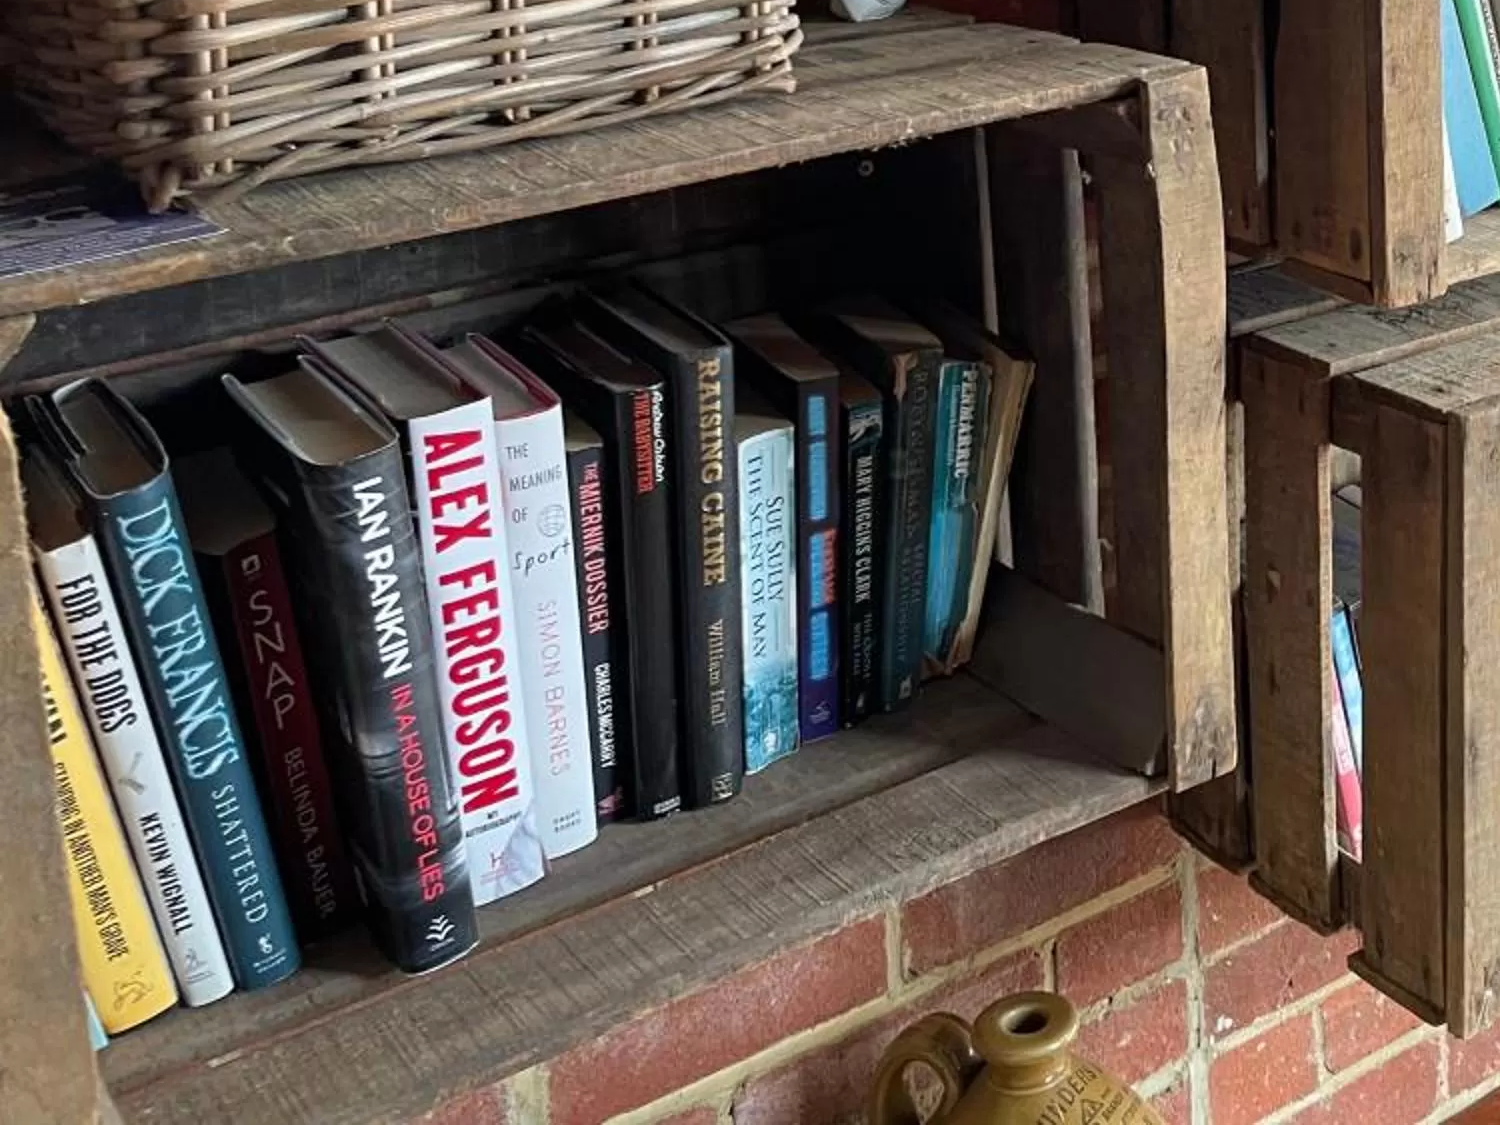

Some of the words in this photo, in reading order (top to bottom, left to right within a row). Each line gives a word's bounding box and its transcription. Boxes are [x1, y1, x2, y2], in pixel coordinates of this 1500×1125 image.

[697, 356, 725, 485] RAISING
[953, 369, 979, 480] PENMARRIC
[504, 443, 529, 462] THE
[508, 465, 564, 492] MEANING
[583, 460, 599, 484] THE
[747, 454, 764, 501] THE
[855, 455, 873, 495] MARY
[351, 475, 390, 543] IAN
[422, 429, 493, 555] ALEX
[511, 506, 530, 525] OF
[578, 481, 606, 559] MIERNIK
[765, 495, 784, 540] SUE
[116, 496, 193, 616] DICK
[701, 491, 727, 587] CAINE
[749, 503, 768, 574] SCENT
[855, 495, 873, 557] HIGGINS
[512, 539, 572, 578] Sport
[766, 543, 787, 603] SULLY
[854, 556, 872, 604] CLARK
[55, 573, 104, 624] FOR
[363, 544, 414, 680] RANKIN
[583, 557, 610, 636] DOSSIER
[752, 575, 768, 609] OF
[71, 620, 119, 671] THE
[249, 589, 296, 730] SNAP
[537, 600, 561, 679] SIMON
[708, 618, 726, 688] William
[752, 611, 769, 660] MAY
[85, 667, 139, 735] DOGS
[147, 604, 240, 779] FRANCIS
[390, 682, 414, 711] IN
[438, 559, 520, 814] FERGUSON
[710, 689, 728, 726] Hall
[392, 713, 418, 732] A
[543, 685, 571, 778] BARNES
[397, 729, 431, 816] HOUSE
[64, 817, 86, 838] IN
[139, 811, 173, 865] KEVIN
[211, 783, 270, 924] SHATTERED
[283, 746, 317, 845] BELINDA
[306, 845, 338, 920] BAUER
[411, 813, 438, 851] OF
[67, 833, 104, 890] ANOTHER
[415, 846, 447, 903] LIES
[155, 863, 194, 936] WIGNALL
[98, 920, 130, 963] GRAVE
